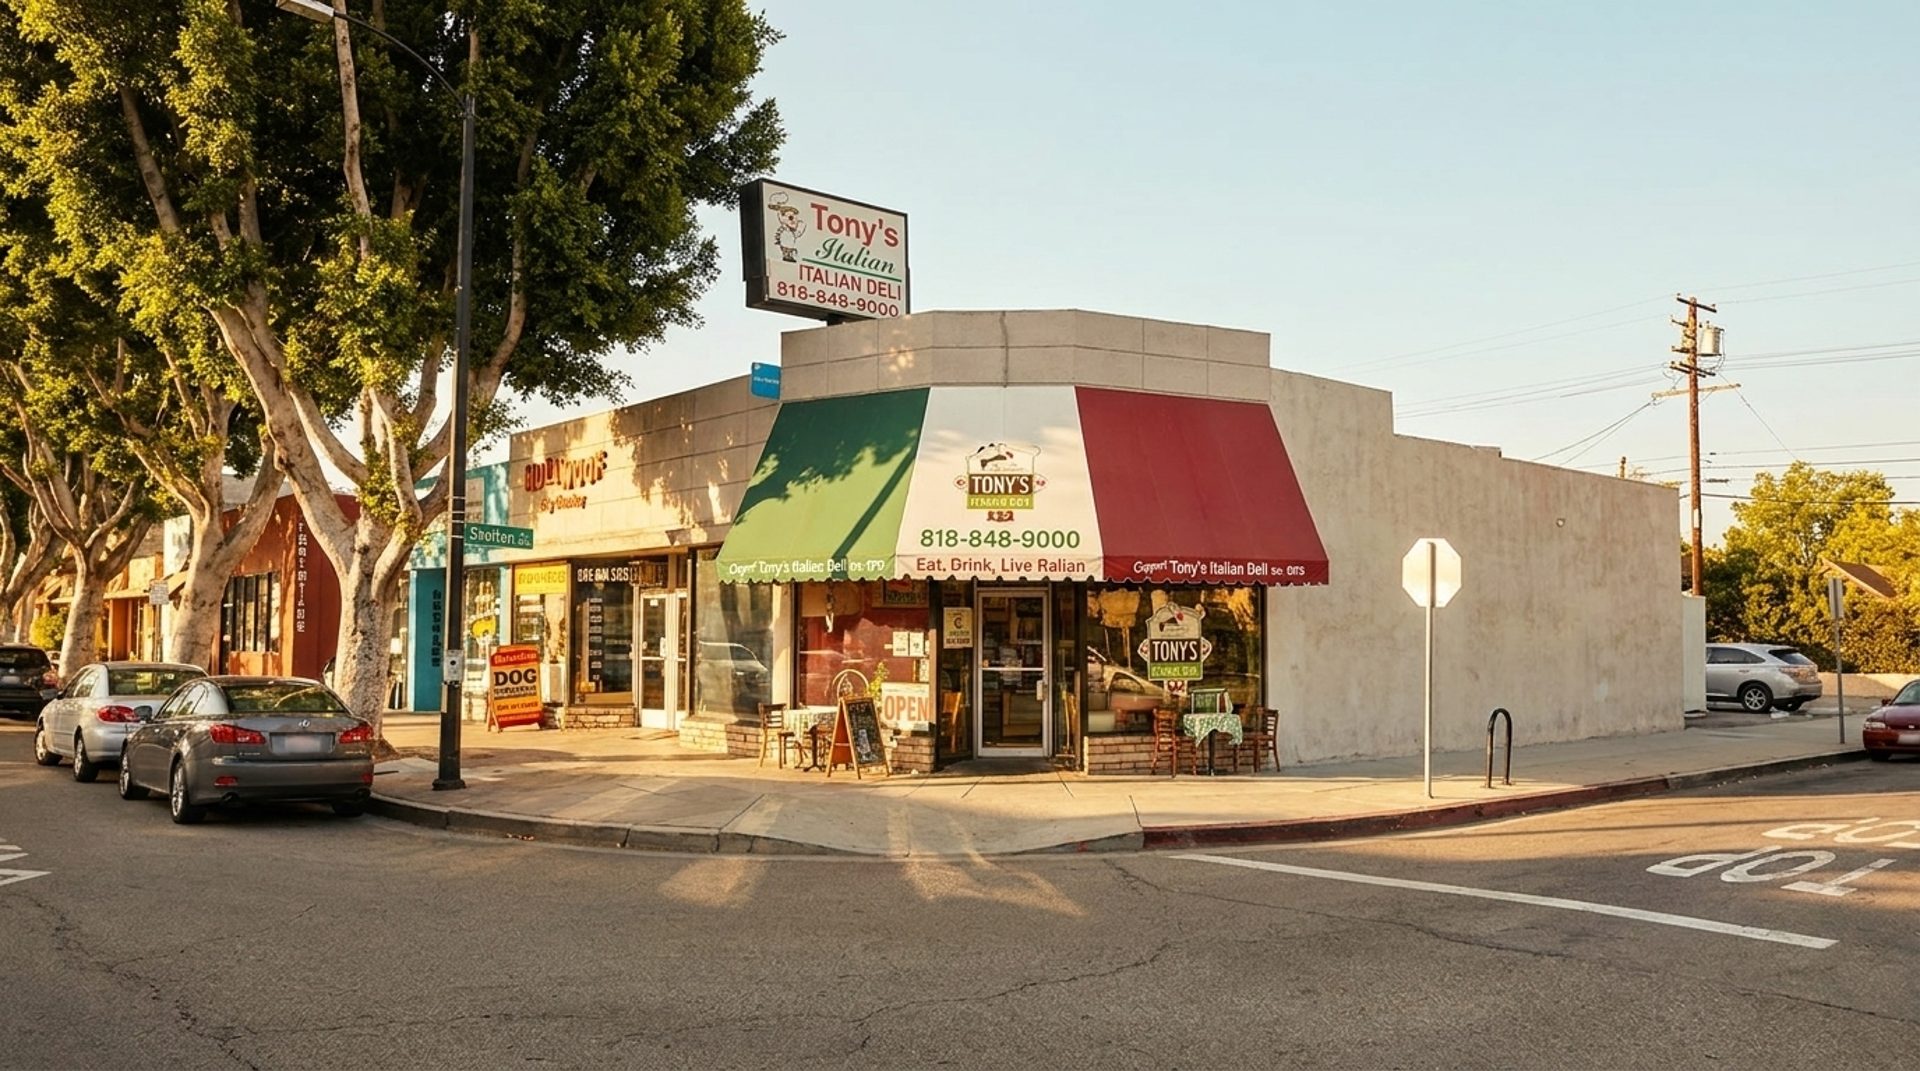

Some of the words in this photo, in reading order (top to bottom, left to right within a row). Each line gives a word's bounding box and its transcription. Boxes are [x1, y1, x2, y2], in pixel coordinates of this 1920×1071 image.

[810, 203, 899, 247] Tony's
[815, 238, 896, 274] Italian
[799, 264, 862, 292] ITALIAN
[867, 279, 901, 301] DELI
[777, 281, 899, 317] 818-848-9000
[971, 475, 1030, 494] TONY'S
[920, 529, 1081, 549] 818-848-9000
[1001, 558, 1033, 573] Live
[1209, 561, 1245, 576] Italian
[494, 668, 537, 687] DOG
[884, 695, 930, 722] OPEN
